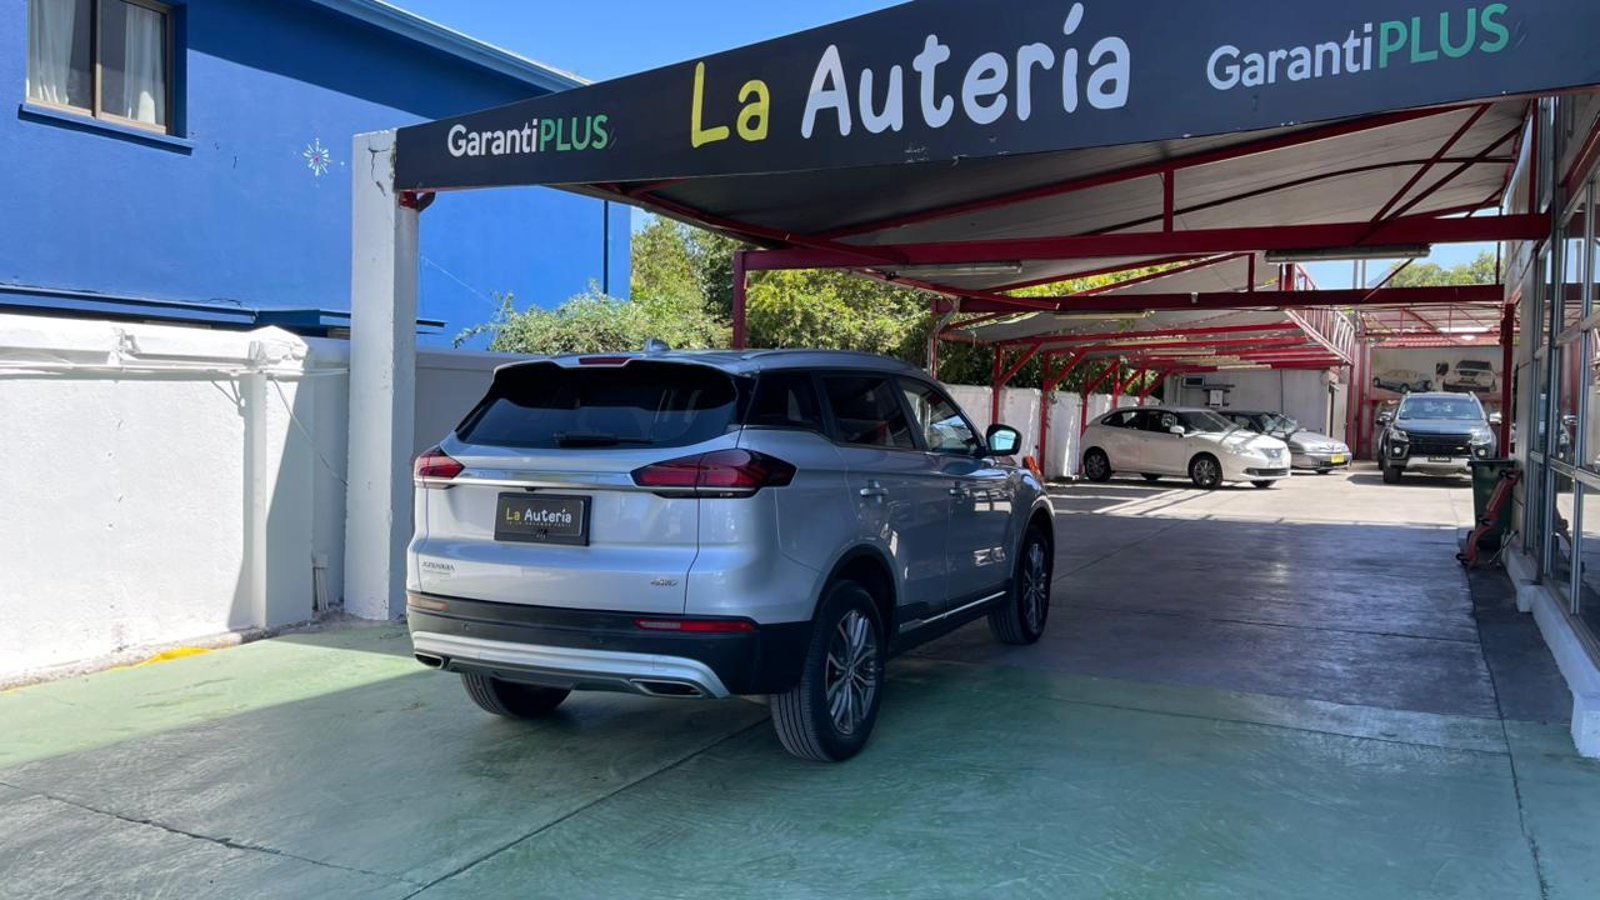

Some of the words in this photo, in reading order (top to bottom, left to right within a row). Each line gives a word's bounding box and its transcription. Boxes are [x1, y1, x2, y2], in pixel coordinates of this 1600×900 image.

[691, 61, 770, 148] La
[801, 2, 1131, 139] Autería
[1207, 3, 1510, 91] GarantiPLUS
[447, 113, 609, 158] GarantiPLUS
[505, 507, 521, 521] La
[524, 508, 572, 524] Autería
